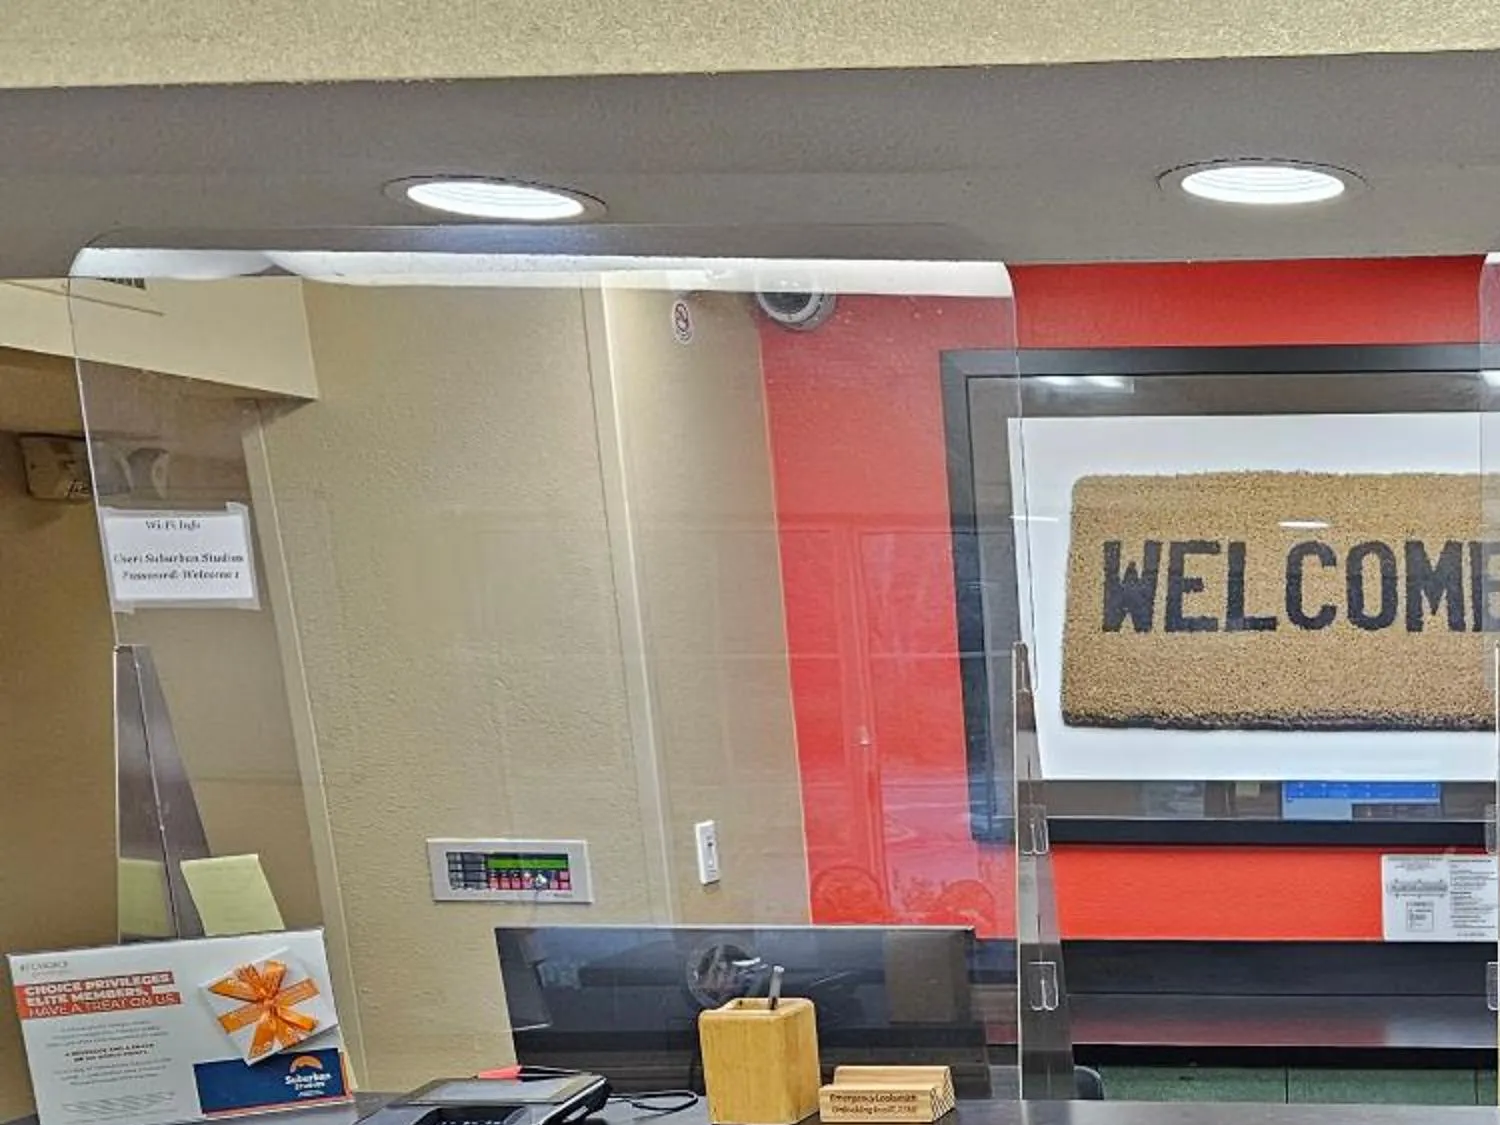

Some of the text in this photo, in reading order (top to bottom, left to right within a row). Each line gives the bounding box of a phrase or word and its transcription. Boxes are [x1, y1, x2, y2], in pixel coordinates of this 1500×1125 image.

[24, 973, 170, 997] CHOICE PRIVILEGES
[26, 993, 70, 1007] ELITE
[29, 1003, 69, 1018] HAVE
[71, 1003, 83, 1014] A
[86, 998, 126, 1012] TREAT
[131, 996, 152, 1009] ON
